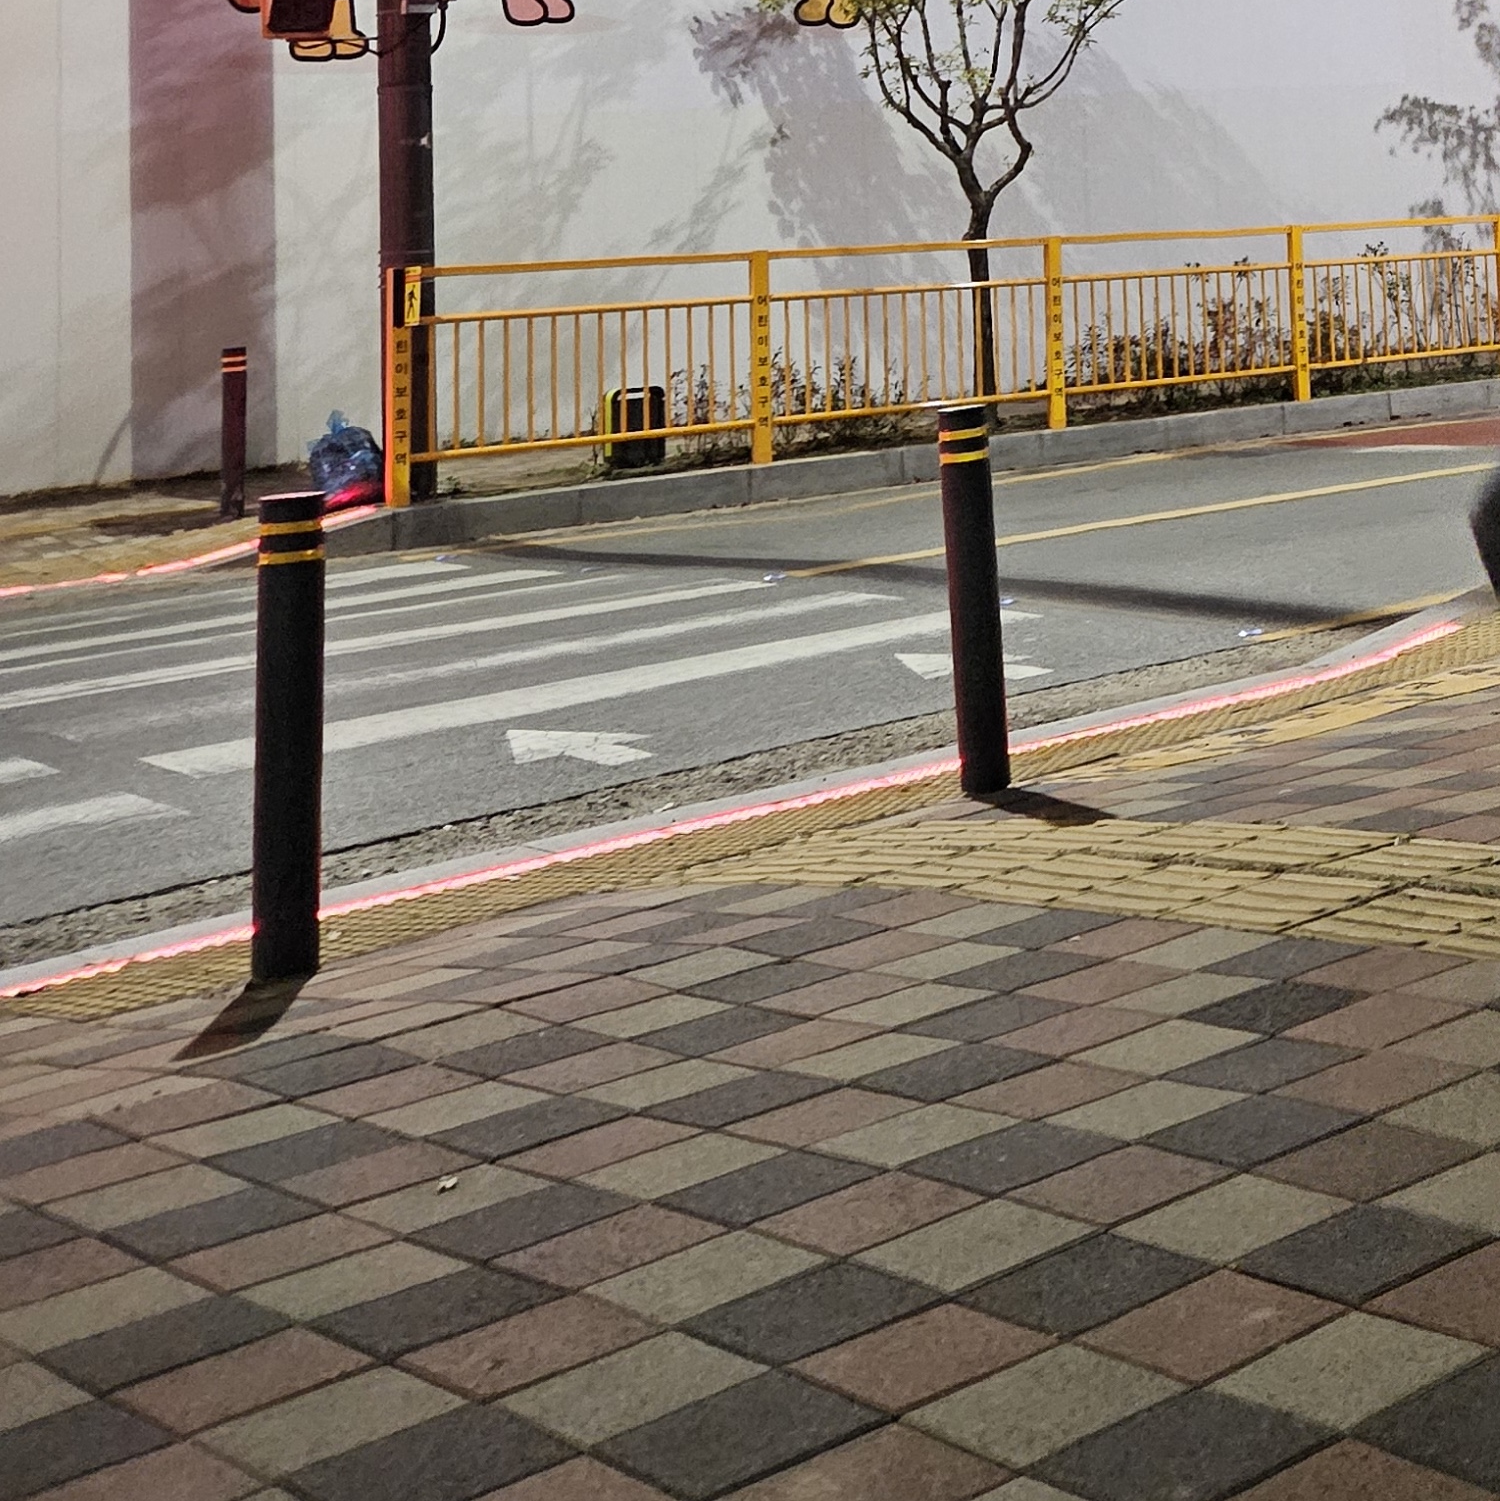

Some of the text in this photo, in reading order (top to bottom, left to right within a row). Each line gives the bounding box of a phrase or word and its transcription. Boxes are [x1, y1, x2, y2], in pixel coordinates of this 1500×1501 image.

[756, 293, 771, 429] 어린이보호구역
[1051, 275, 1066, 399] 어린이보호구역
[393, 338, 408, 467] 린이보호구역
